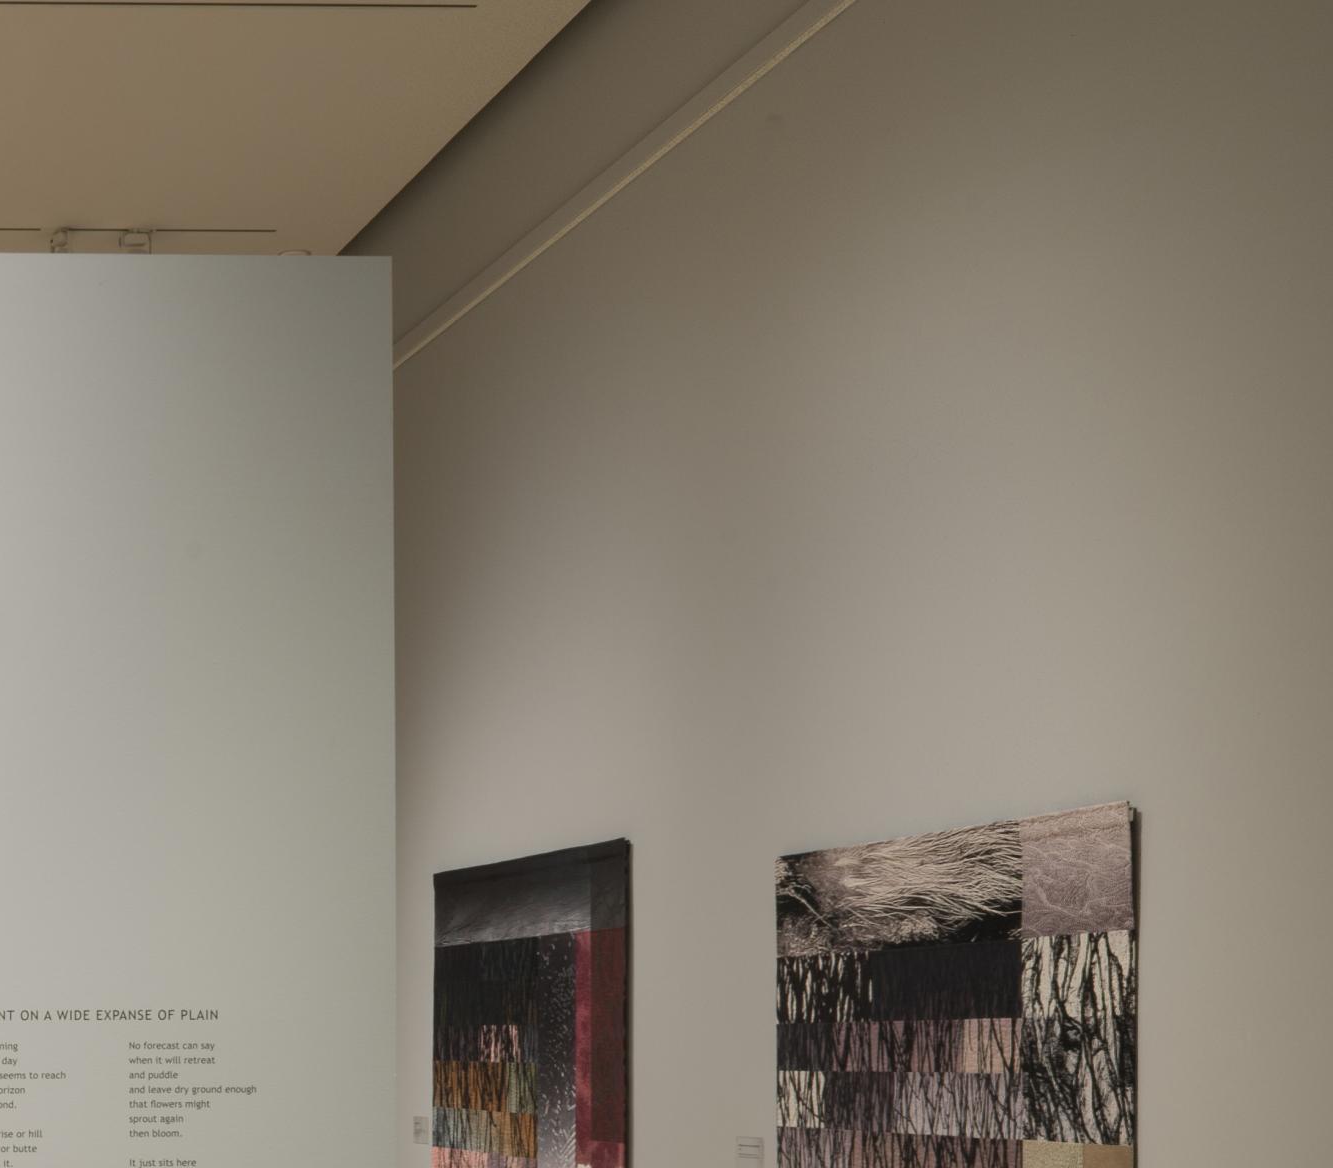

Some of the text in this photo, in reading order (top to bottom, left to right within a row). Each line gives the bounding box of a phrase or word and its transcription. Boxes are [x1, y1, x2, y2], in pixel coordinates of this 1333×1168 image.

[20, 1010, 39, 1021] ON
[44, 1010, 53, 1021] A
[57, 1010, 90, 1021] WIDE
[96, 1010, 152, 1021] EXPANSE
[158, 1010, 175, 1021] OF
[181, 1010, 218, 1021] PLAIN
[128, 1041, 141, 1050] No
[143, 1041, 180, 1050] forecast
[200, 1043, 215, 1052] say
[1, 1056, 18, 1067] day
[128, 1056, 153, 1064] when
[164, 1056, 181, 1064] will
[183, 1056, 215, 1064] retreat
[29, 1071, 39, 1080] to
[41, 1071, 67, 1080] reach
[129, 1070, 179, 1081] and puddle
[129, 1085, 257, 1096] and leave dry ground enough
[129, 1100, 211, 1111] that flowers might
[129, 1114, 184, 1125] sprout again
[28, 1129, 43, 1138] hill
[129, 1129, 150, 1138] then
[13, 1144, 38, 1153] butte
[129, 1158, 197, 1168] It just sits here
